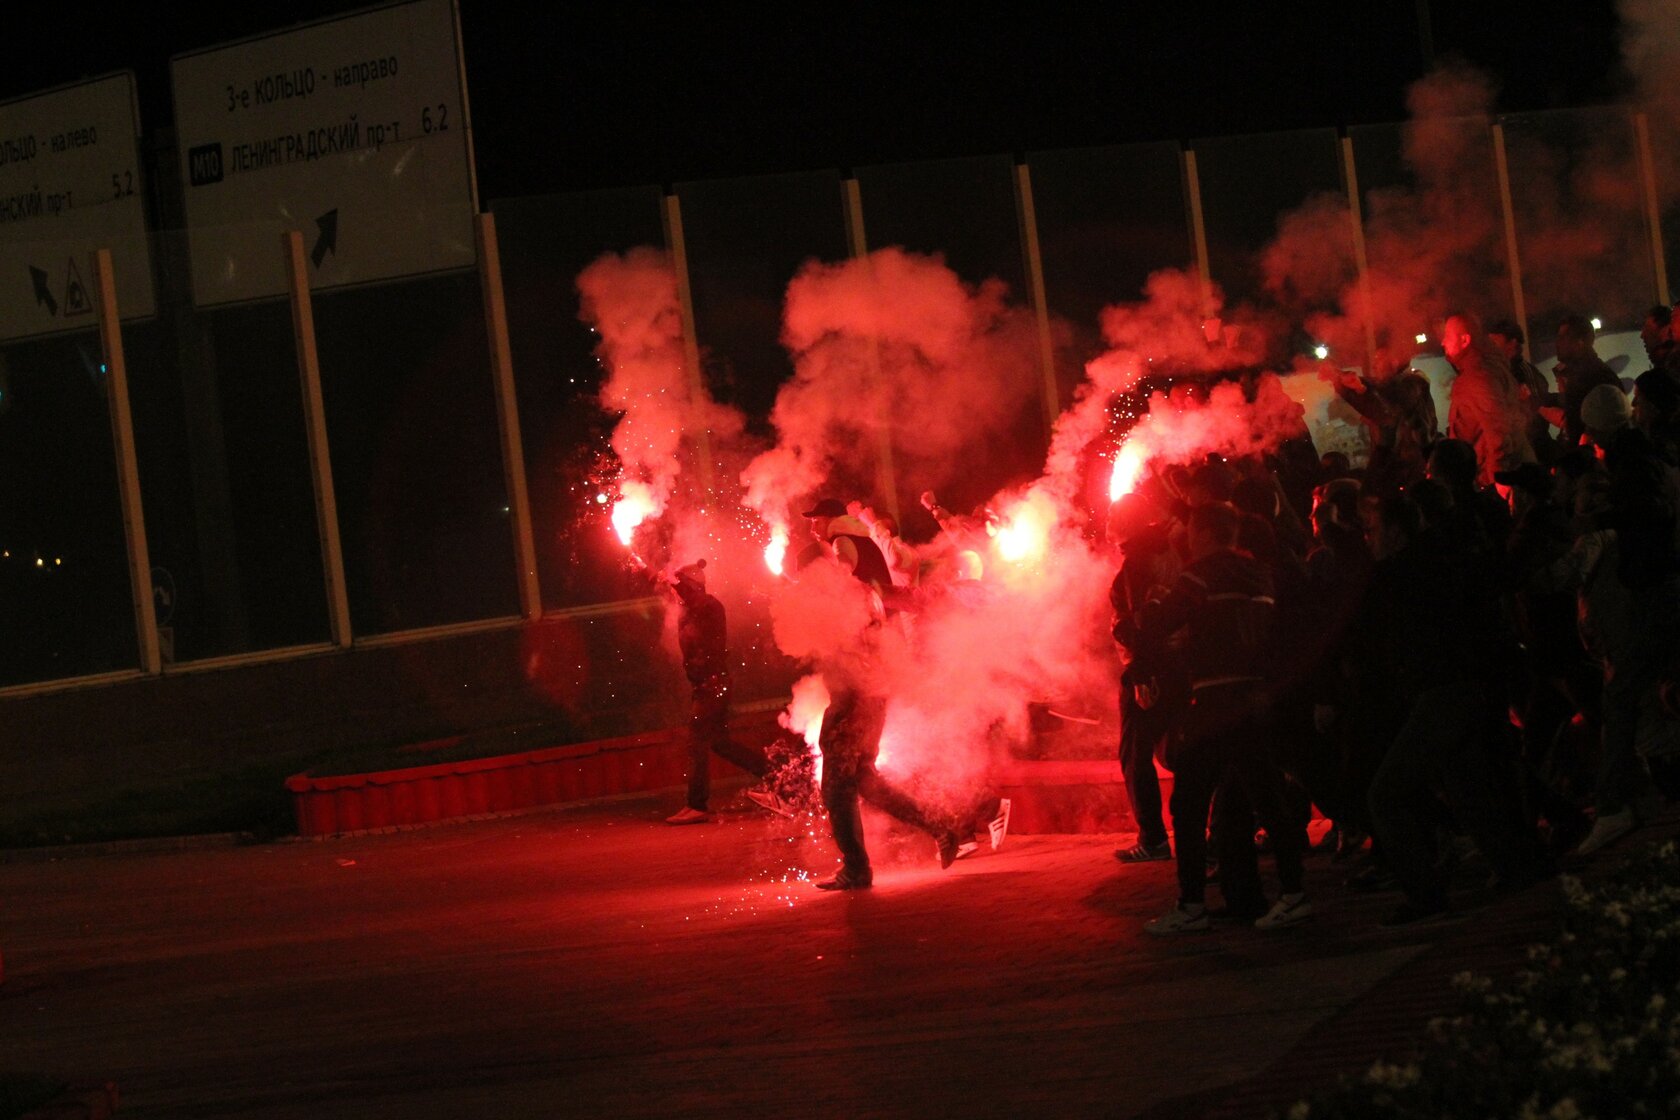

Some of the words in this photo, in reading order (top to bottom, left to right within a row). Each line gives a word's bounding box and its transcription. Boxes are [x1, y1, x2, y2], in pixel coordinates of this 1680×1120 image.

[227, 86, 249, 112] 3-е
[256, 68, 315, 104] КОЛЬЦО
[334, 56, 397, 89] направо
[50, 126, 97, 153] налево
[232, 114, 359, 173] ЛЕНИНГРАДСКИЙ
[367, 122, 399, 152] пр-т
[422, 104, 447, 134] 6.2
[0, 186, 41, 221] НСКИЙ
[112, 170, 133, 198] 5.2
